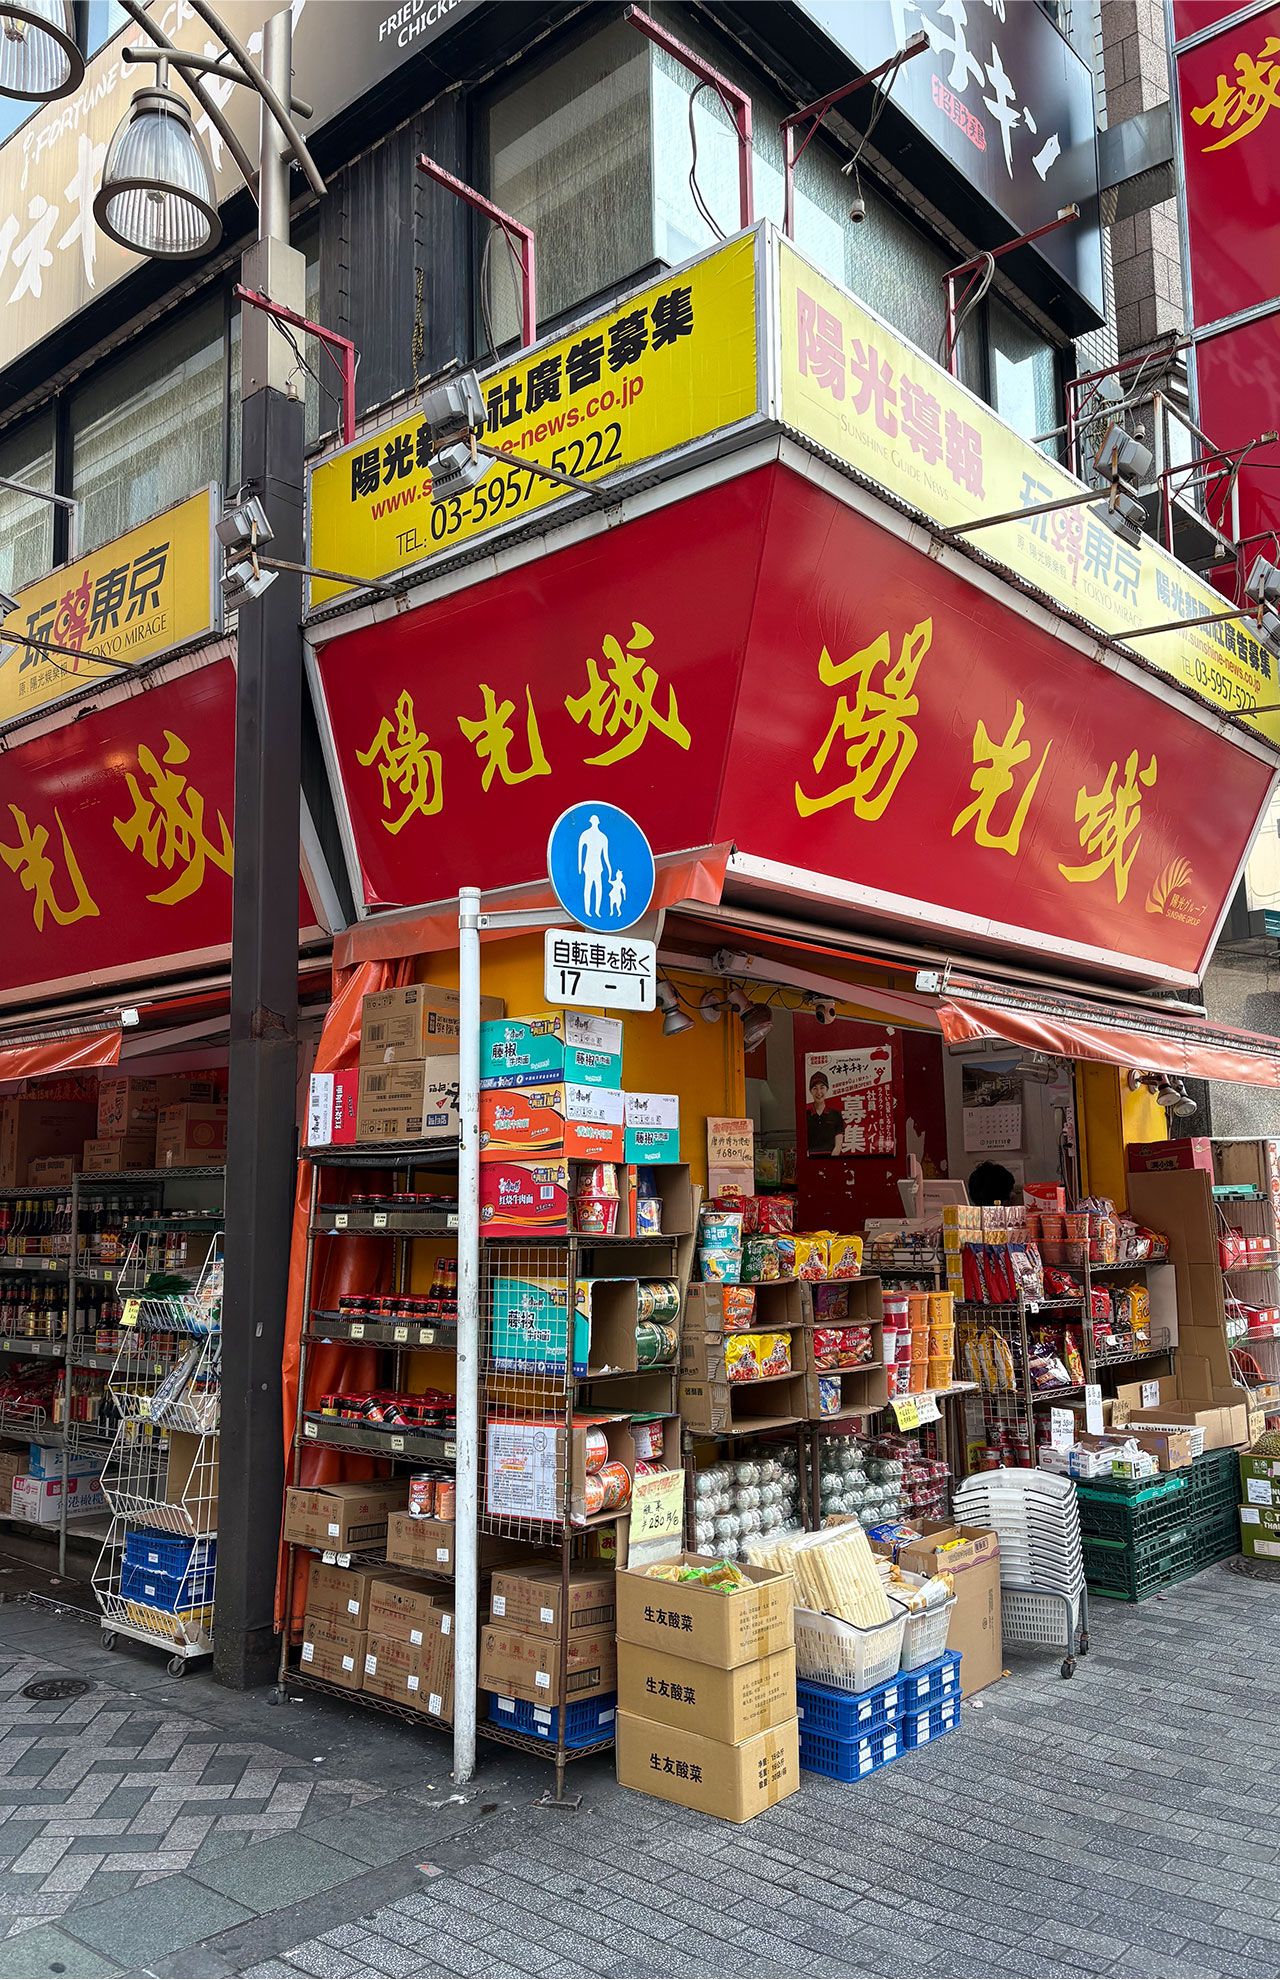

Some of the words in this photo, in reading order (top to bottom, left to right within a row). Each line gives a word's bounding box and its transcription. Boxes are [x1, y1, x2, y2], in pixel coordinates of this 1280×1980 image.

[379, 0, 423, 42] FRIED
[397, 0, 462, 48] CHICKE
[352, 285, 694, 502] 陽光新社廣告募集
[796, 288, 986, 502] 陽光導報
[371, 373, 645, 521] www.se-news.co.jp
[1082, 579, 1113, 611] TOKYO
[1113, 601, 1145, 627] MIRAGE
[86, 636, 123, 665] TOKYO
[124, 613, 167, 645] MIRAGE
[355, 621, 692, 836] 陽光城
[794, 616, 1159, 904] 陽光城
[0, 728, 235, 933] 光城
[553, 940, 651, 973] 自転車を除く
[559, 971, 581, 997] 17
[638, 978, 645, 1003] 1
[841, 1095, 867, 1153] 募集
[643, 1605, 693, 1633] 生友酸菜
[646, 1676, 696, 1706] 生友酸菜
[649, 1752, 703, 1784] 生友酸菜
